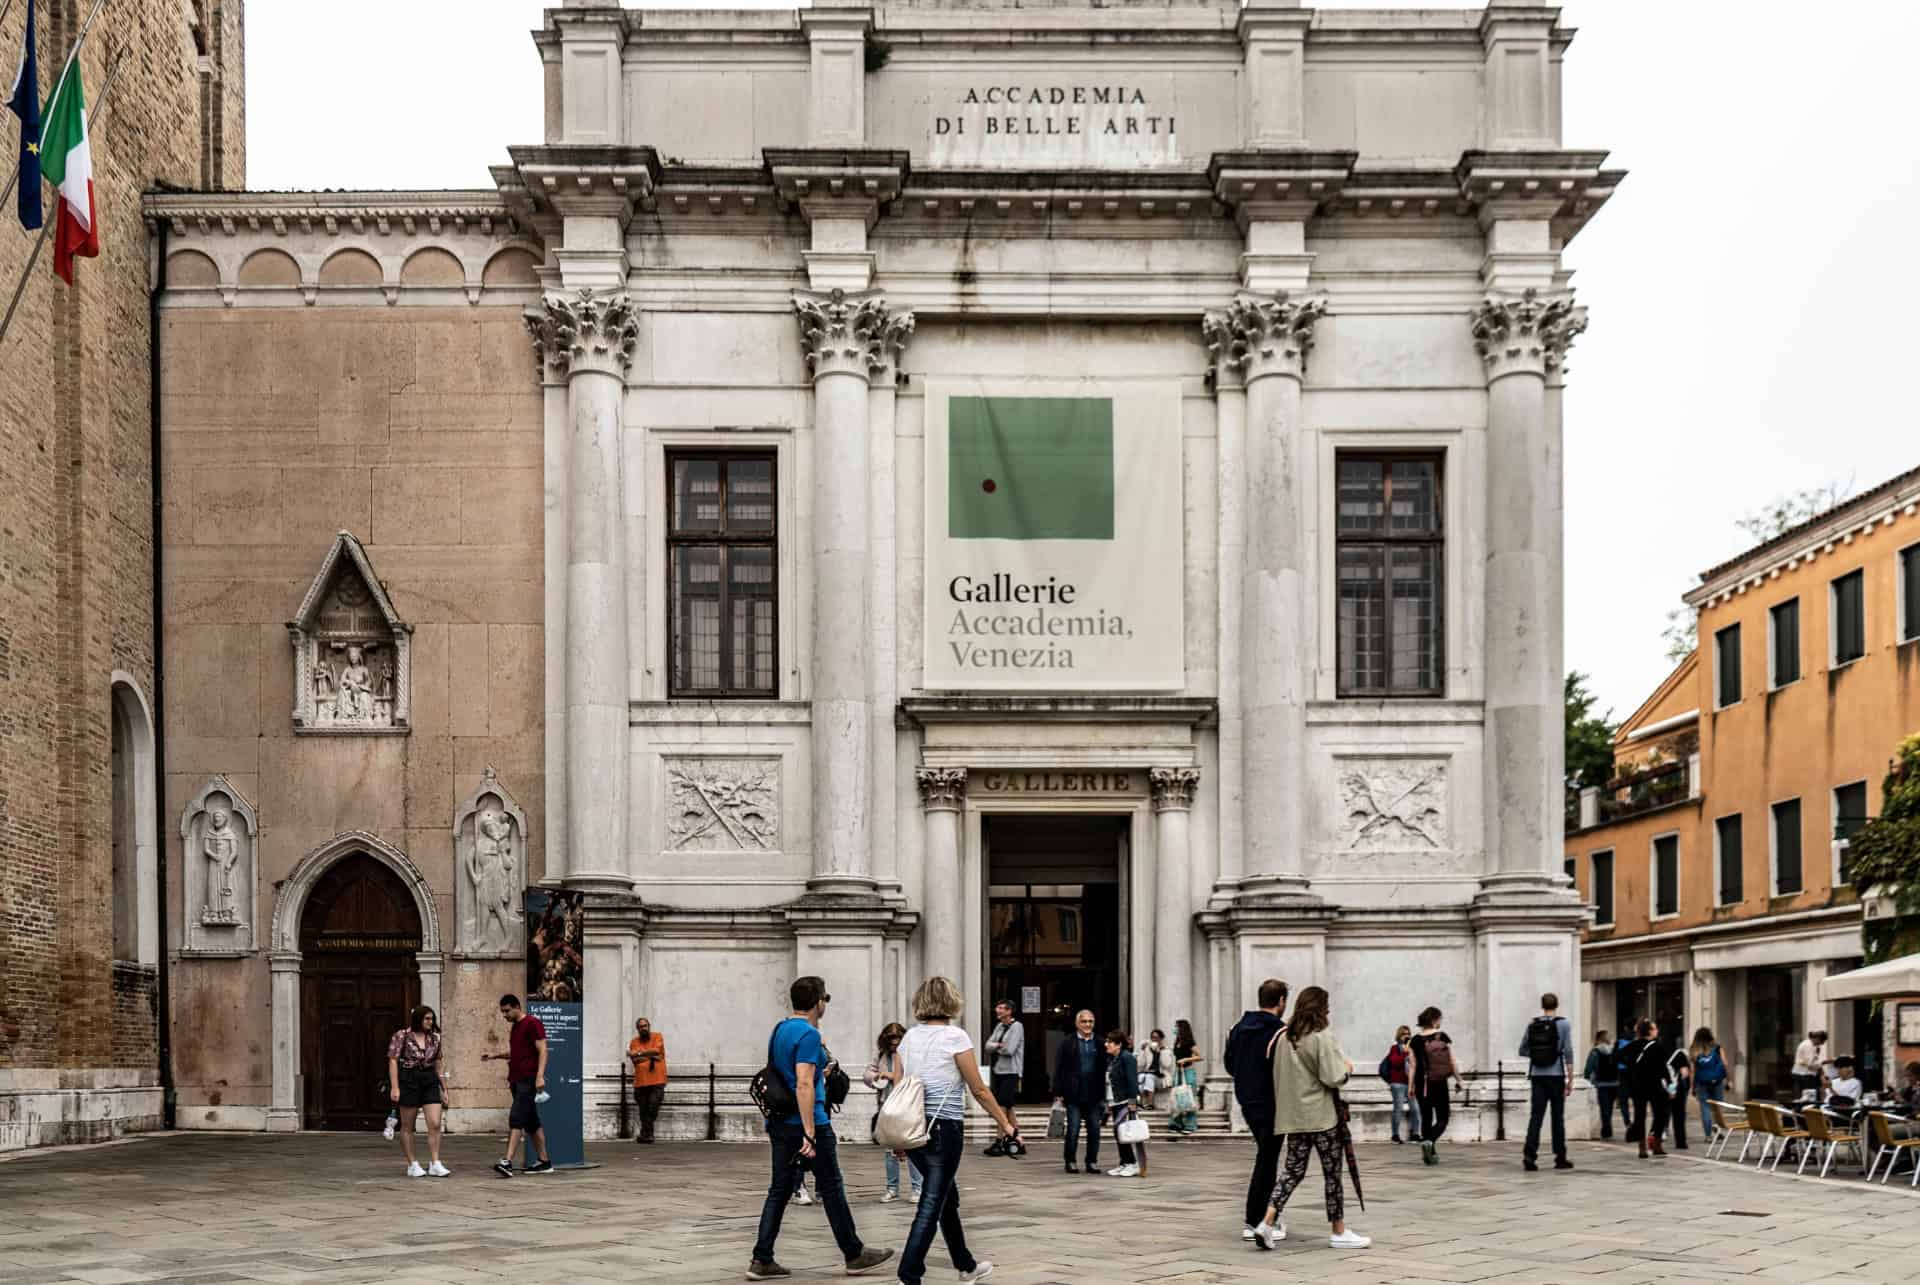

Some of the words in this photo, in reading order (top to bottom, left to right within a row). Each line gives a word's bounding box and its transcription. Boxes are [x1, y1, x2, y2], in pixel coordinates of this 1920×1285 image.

[964, 87, 1145, 104] ACCADEMIA
[936, 117, 964, 134] DI
[987, 117, 1080, 134] BELLE
[1104, 117, 1176, 134] ARTI
[949, 573, 1076, 604] Gallerie
[949, 608, 1134, 638] Accademia,
[949, 642, 1075, 668] Venezia
[983, 773, 1130, 791] GALLERIE
